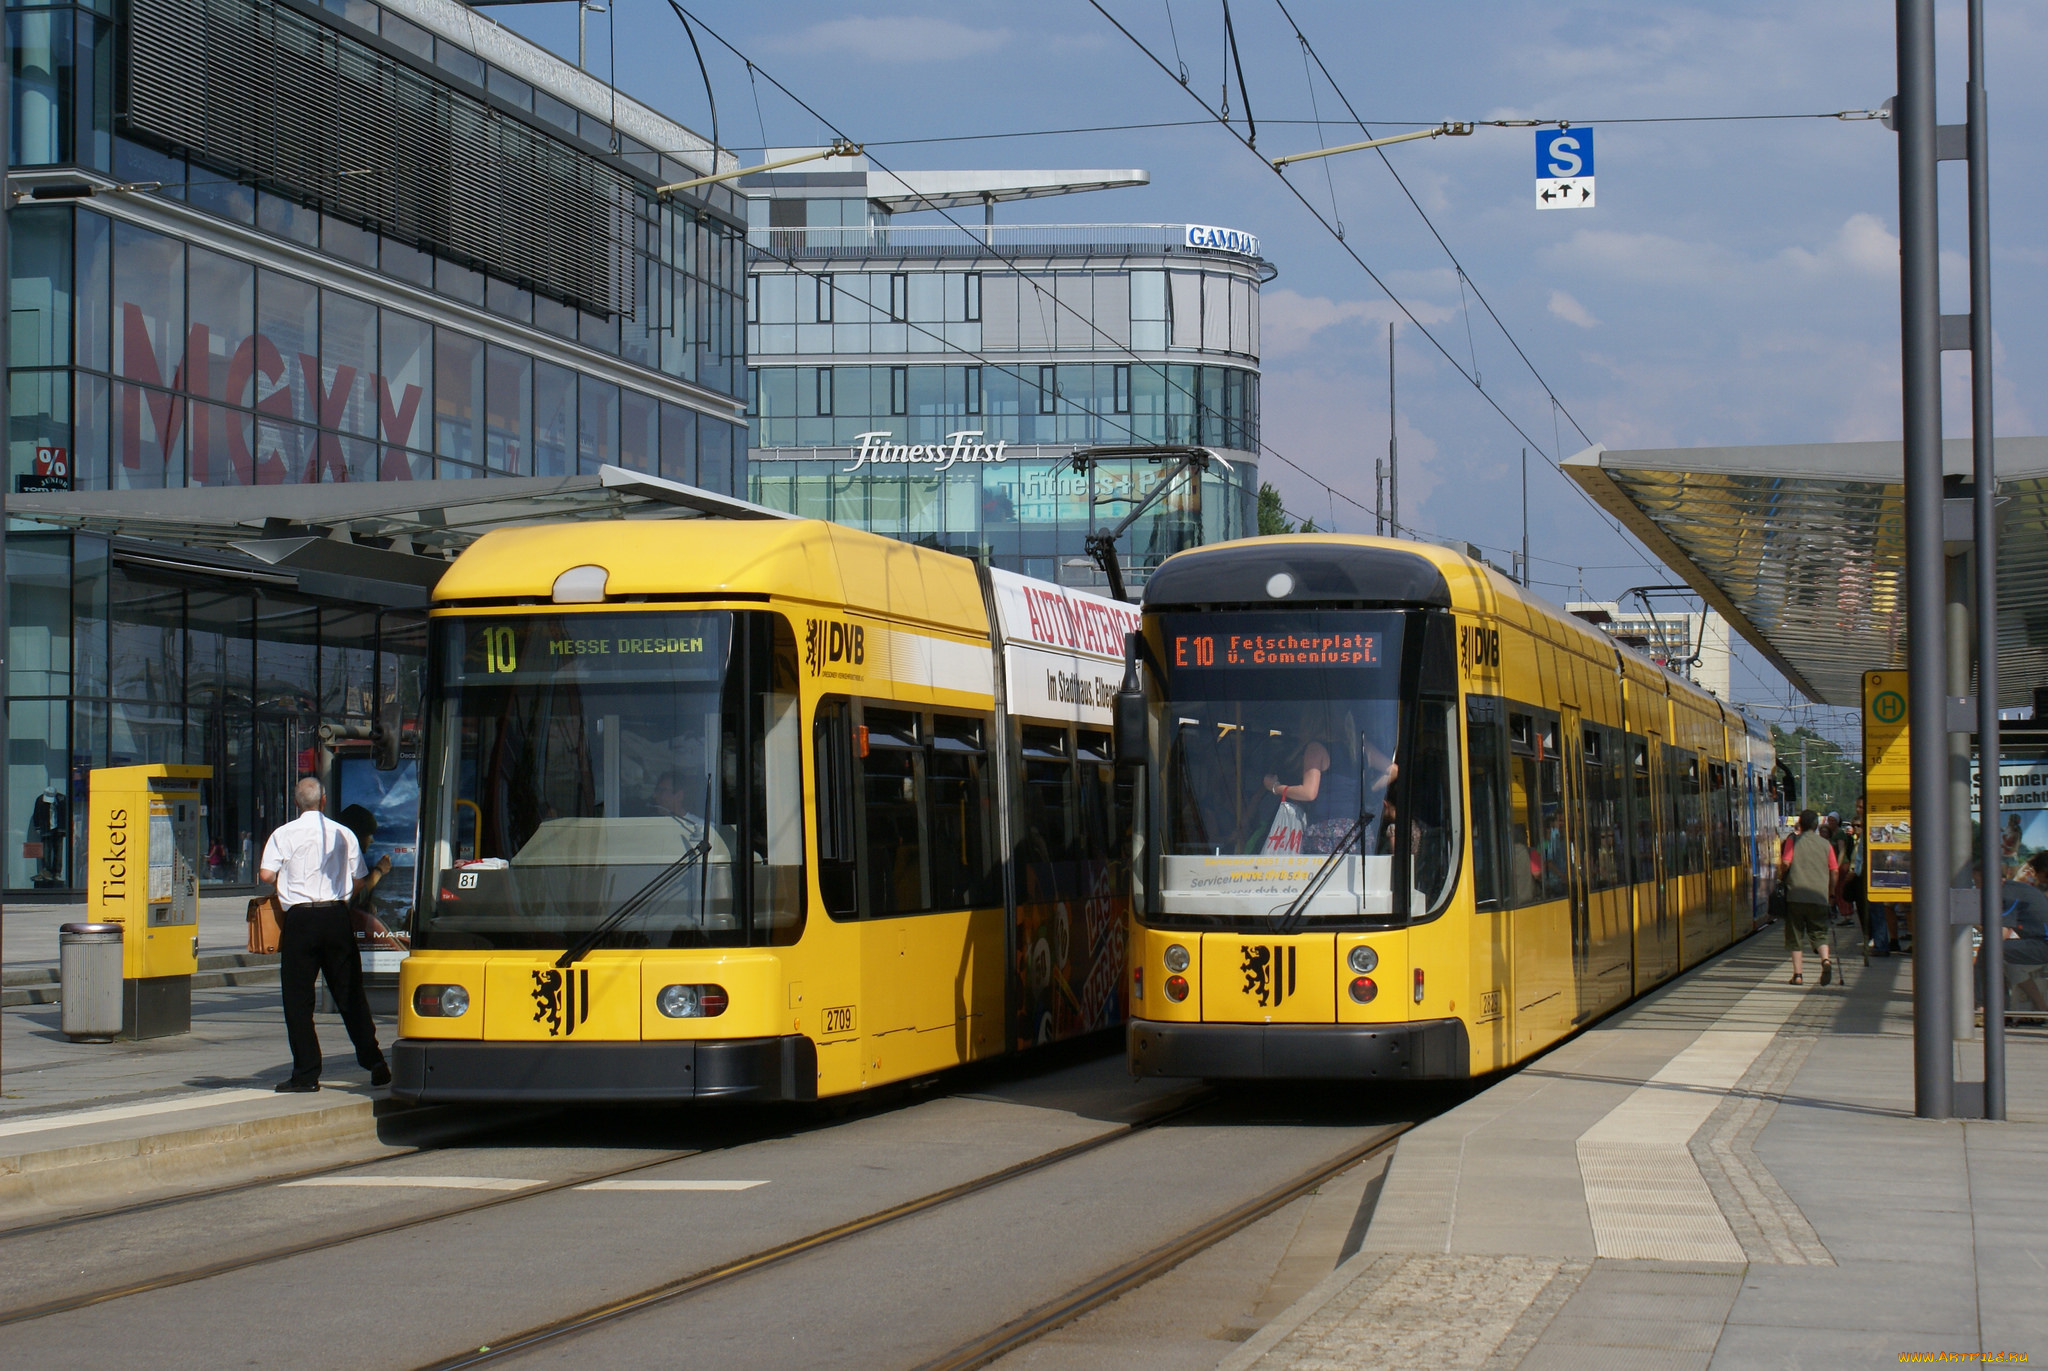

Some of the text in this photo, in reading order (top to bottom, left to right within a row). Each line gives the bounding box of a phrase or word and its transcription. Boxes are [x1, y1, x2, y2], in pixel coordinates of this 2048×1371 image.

[1548, 136, 1583, 178] S
[483, 626, 703, 674] 10 MESSE DRESDEN
[829, 621, 865, 666] DVB
[1176, 634, 1374, 666] E 10 Fetscherplatz
[1253, 648, 1377, 664] Comeniuspl.
[1475, 626, 1499, 668] DVB
[1046, 668, 1058, 702] Im
[1058, 670, 1095, 711] Stadthaus,
[1881, 698, 1897, 716] H
[103, 809, 127, 906] Tickets
[461, 874, 475, 887] 81
[827, 1008, 851, 1031] 2709
